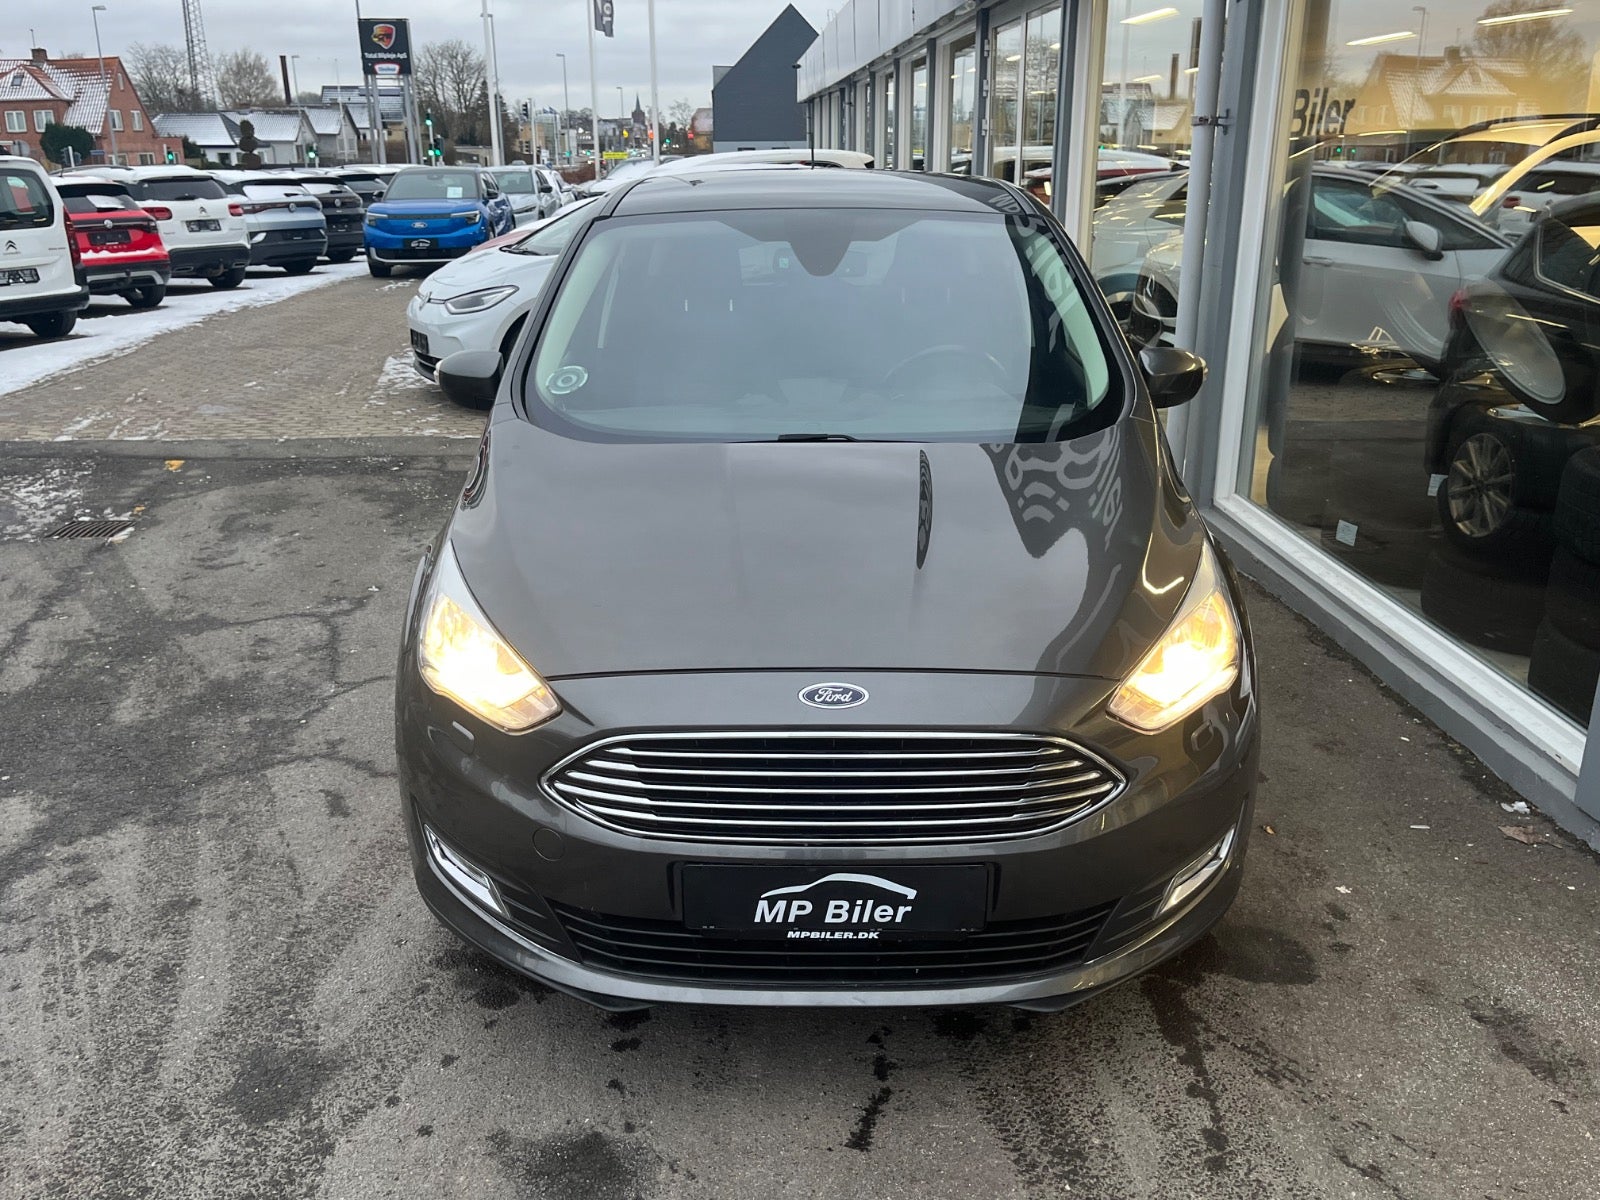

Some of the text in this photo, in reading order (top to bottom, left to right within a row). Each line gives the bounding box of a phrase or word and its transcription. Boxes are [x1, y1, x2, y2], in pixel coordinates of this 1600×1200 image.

[1291, 87, 1357, 136] Biler
[814, 687, 853, 703] Ford
[754, 899, 912, 923] MP Biler
[786, 930, 880, 940] MPBILER.DK
